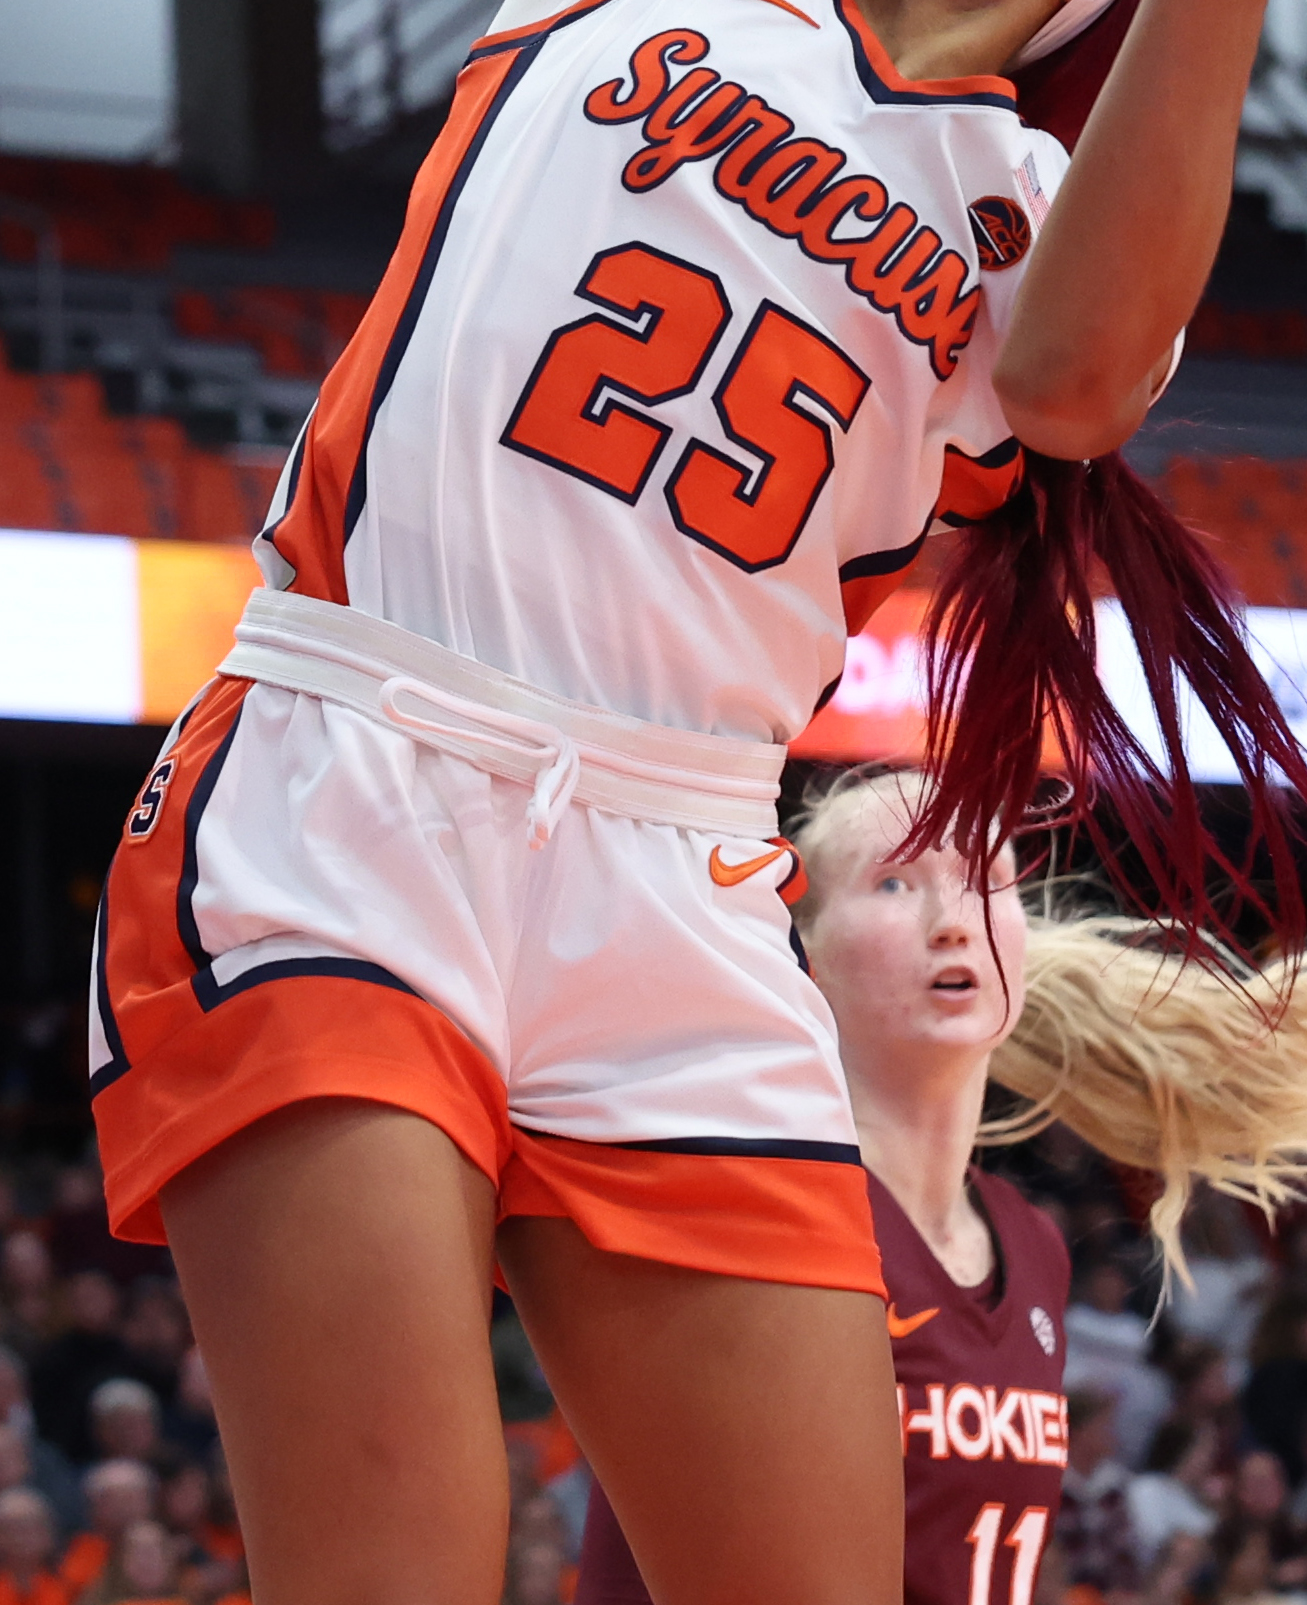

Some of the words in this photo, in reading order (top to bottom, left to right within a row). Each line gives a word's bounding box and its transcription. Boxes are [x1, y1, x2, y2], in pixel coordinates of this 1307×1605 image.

[584, 28, 981, 382] Syracuse
[500, 240, 871, 573] 25
[128, 757, 177, 839] S
[896, 1383, 1068, 1468] HOKIE
[965, 1501, 1049, 1605] 11
